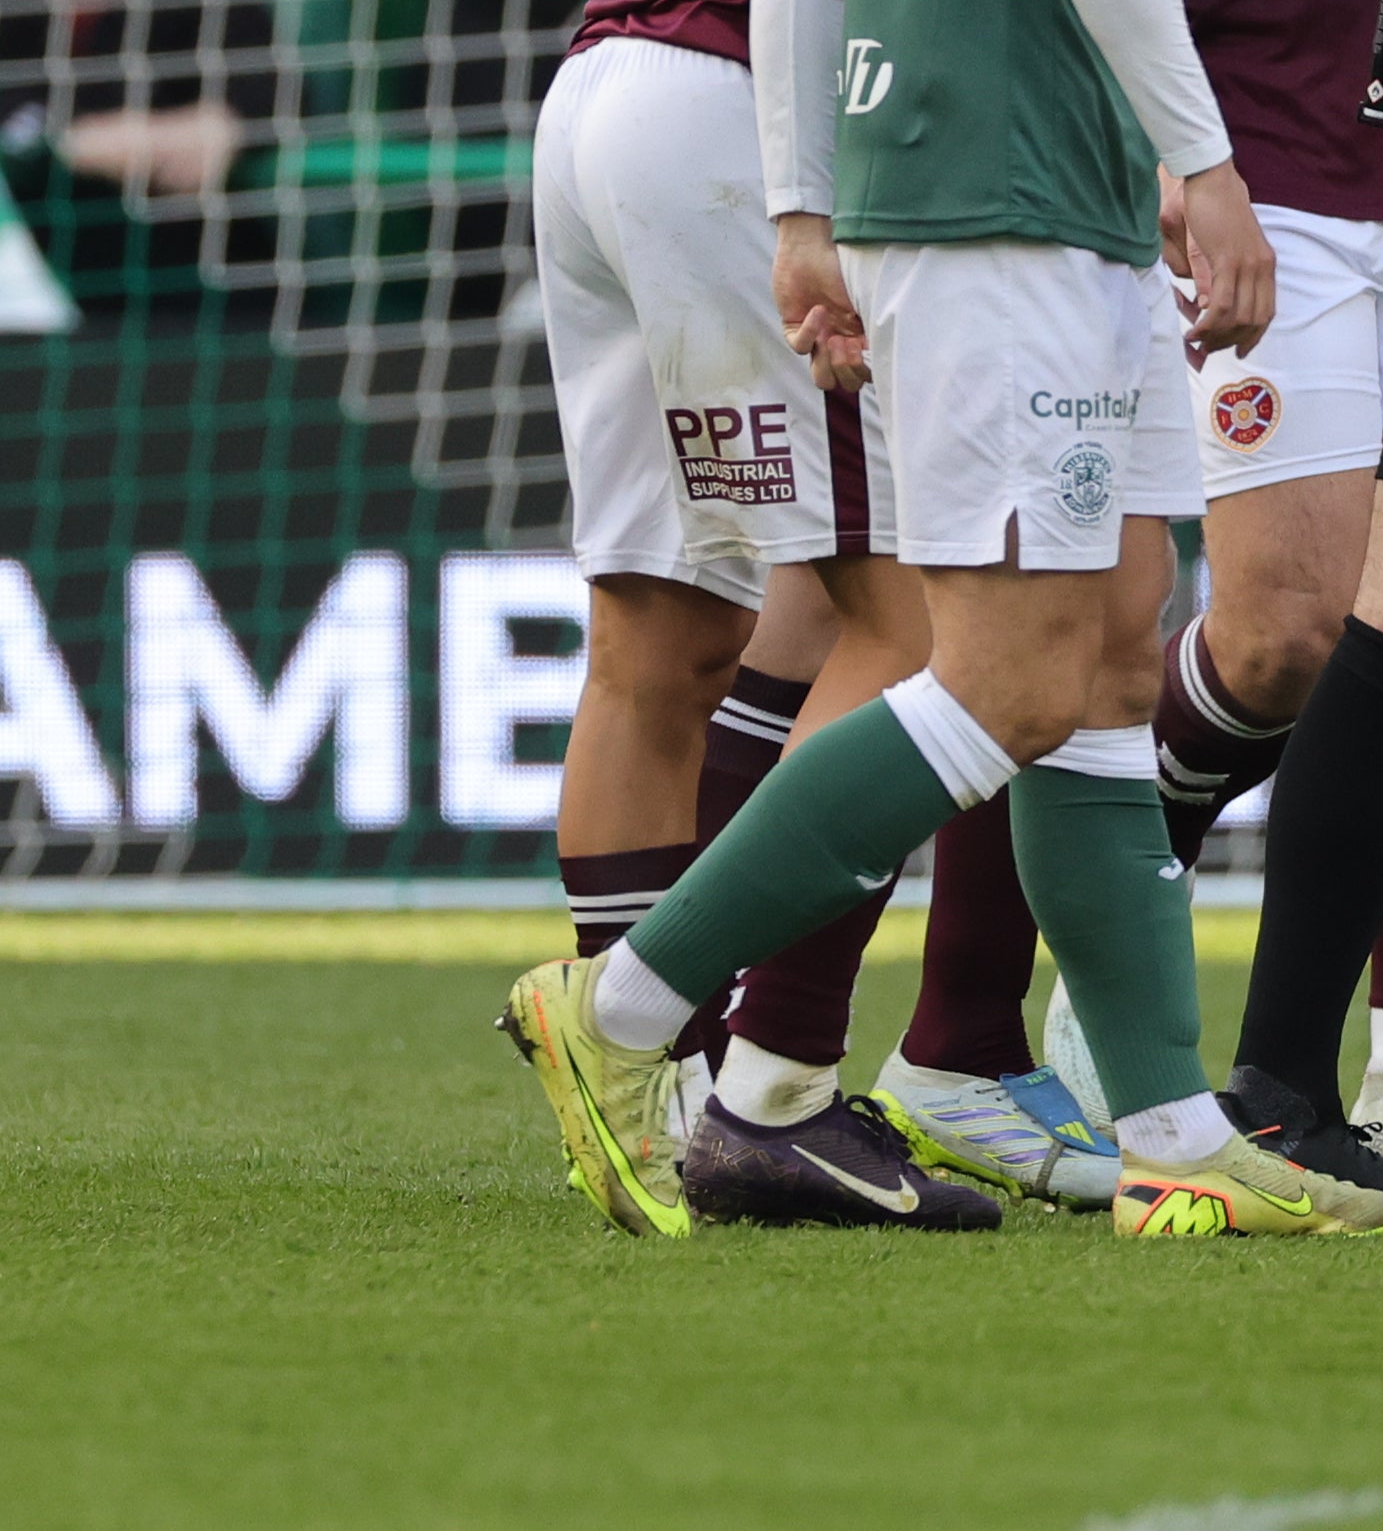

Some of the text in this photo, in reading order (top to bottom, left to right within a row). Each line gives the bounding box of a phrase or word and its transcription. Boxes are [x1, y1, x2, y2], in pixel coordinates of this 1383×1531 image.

[665, 403, 791, 458] PPE
[684, 461, 791, 482] INDUSTRIAL
[759, 484, 793, 501] LTD
